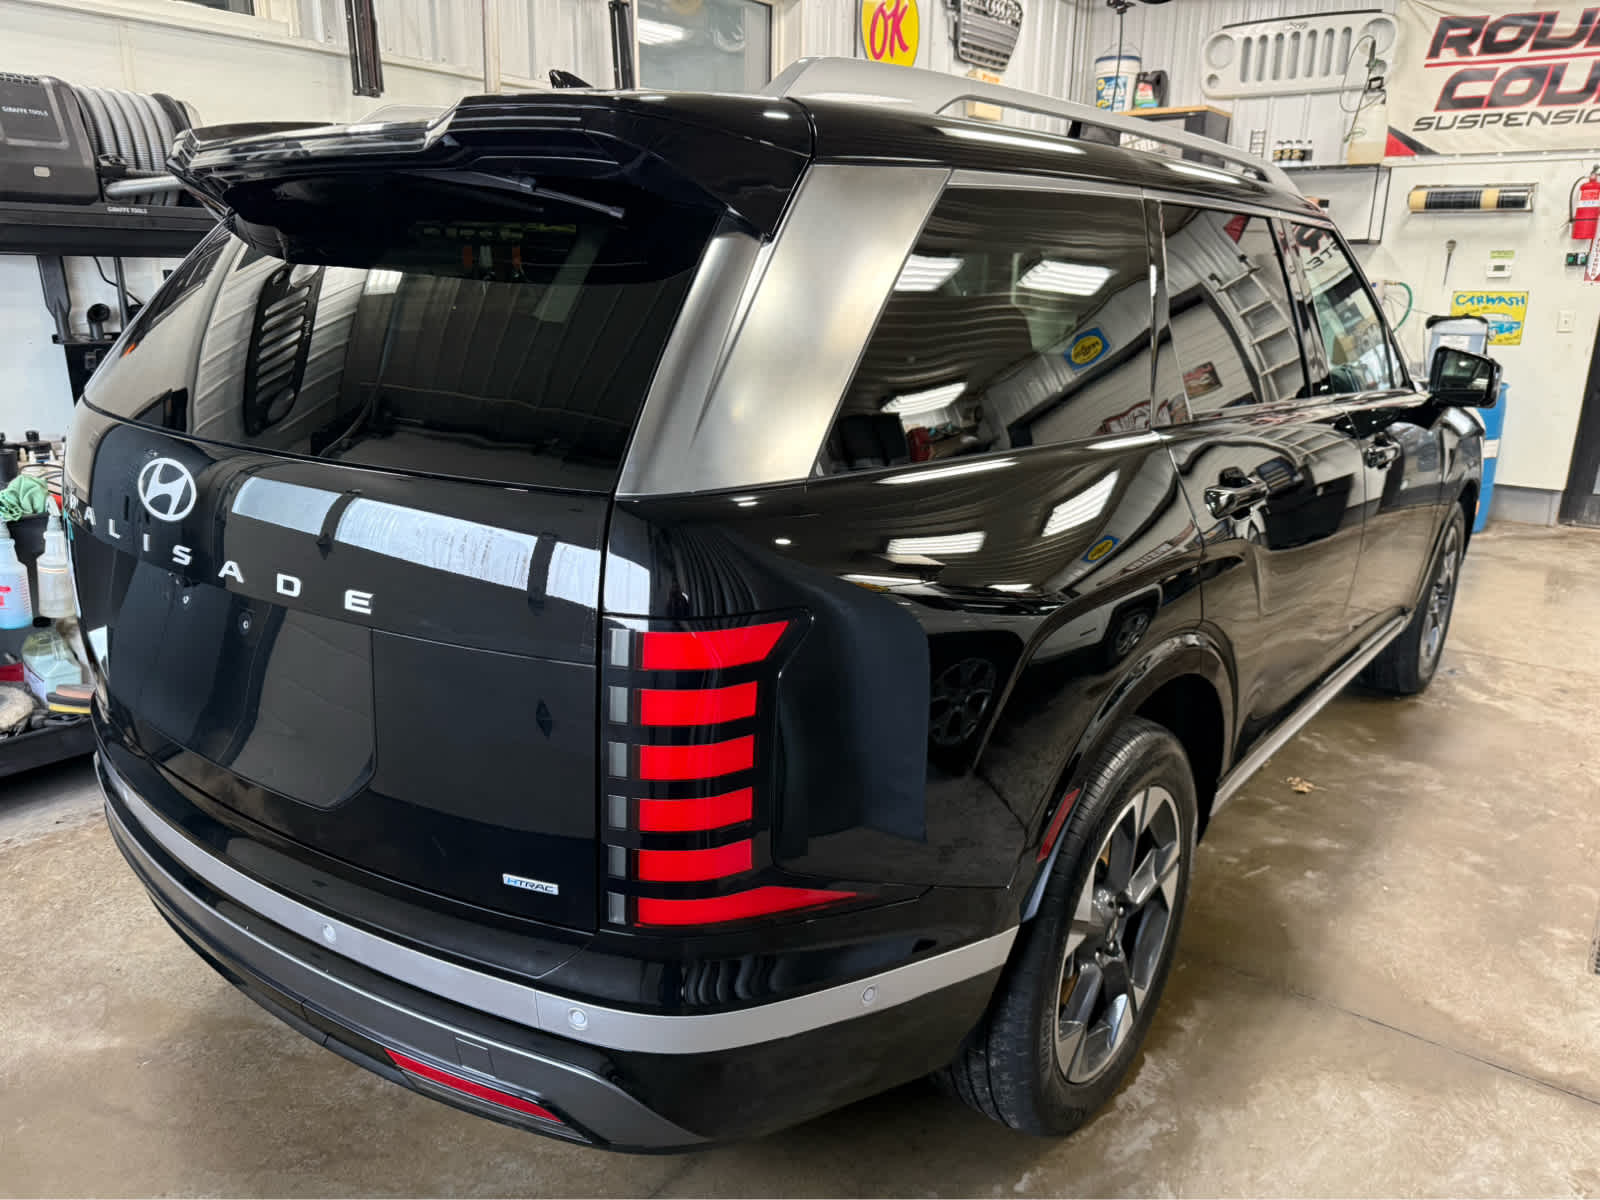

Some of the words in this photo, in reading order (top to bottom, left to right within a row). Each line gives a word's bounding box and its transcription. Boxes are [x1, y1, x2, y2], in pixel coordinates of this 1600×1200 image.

[870, 0, 909, 60] OK
[1425, 8, 1600, 60] ROU
[1434, 60, 1600, 112] COU
[1455, 294, 1525, 307] CARWASH
[506, 876, 556, 894] HTRAC
